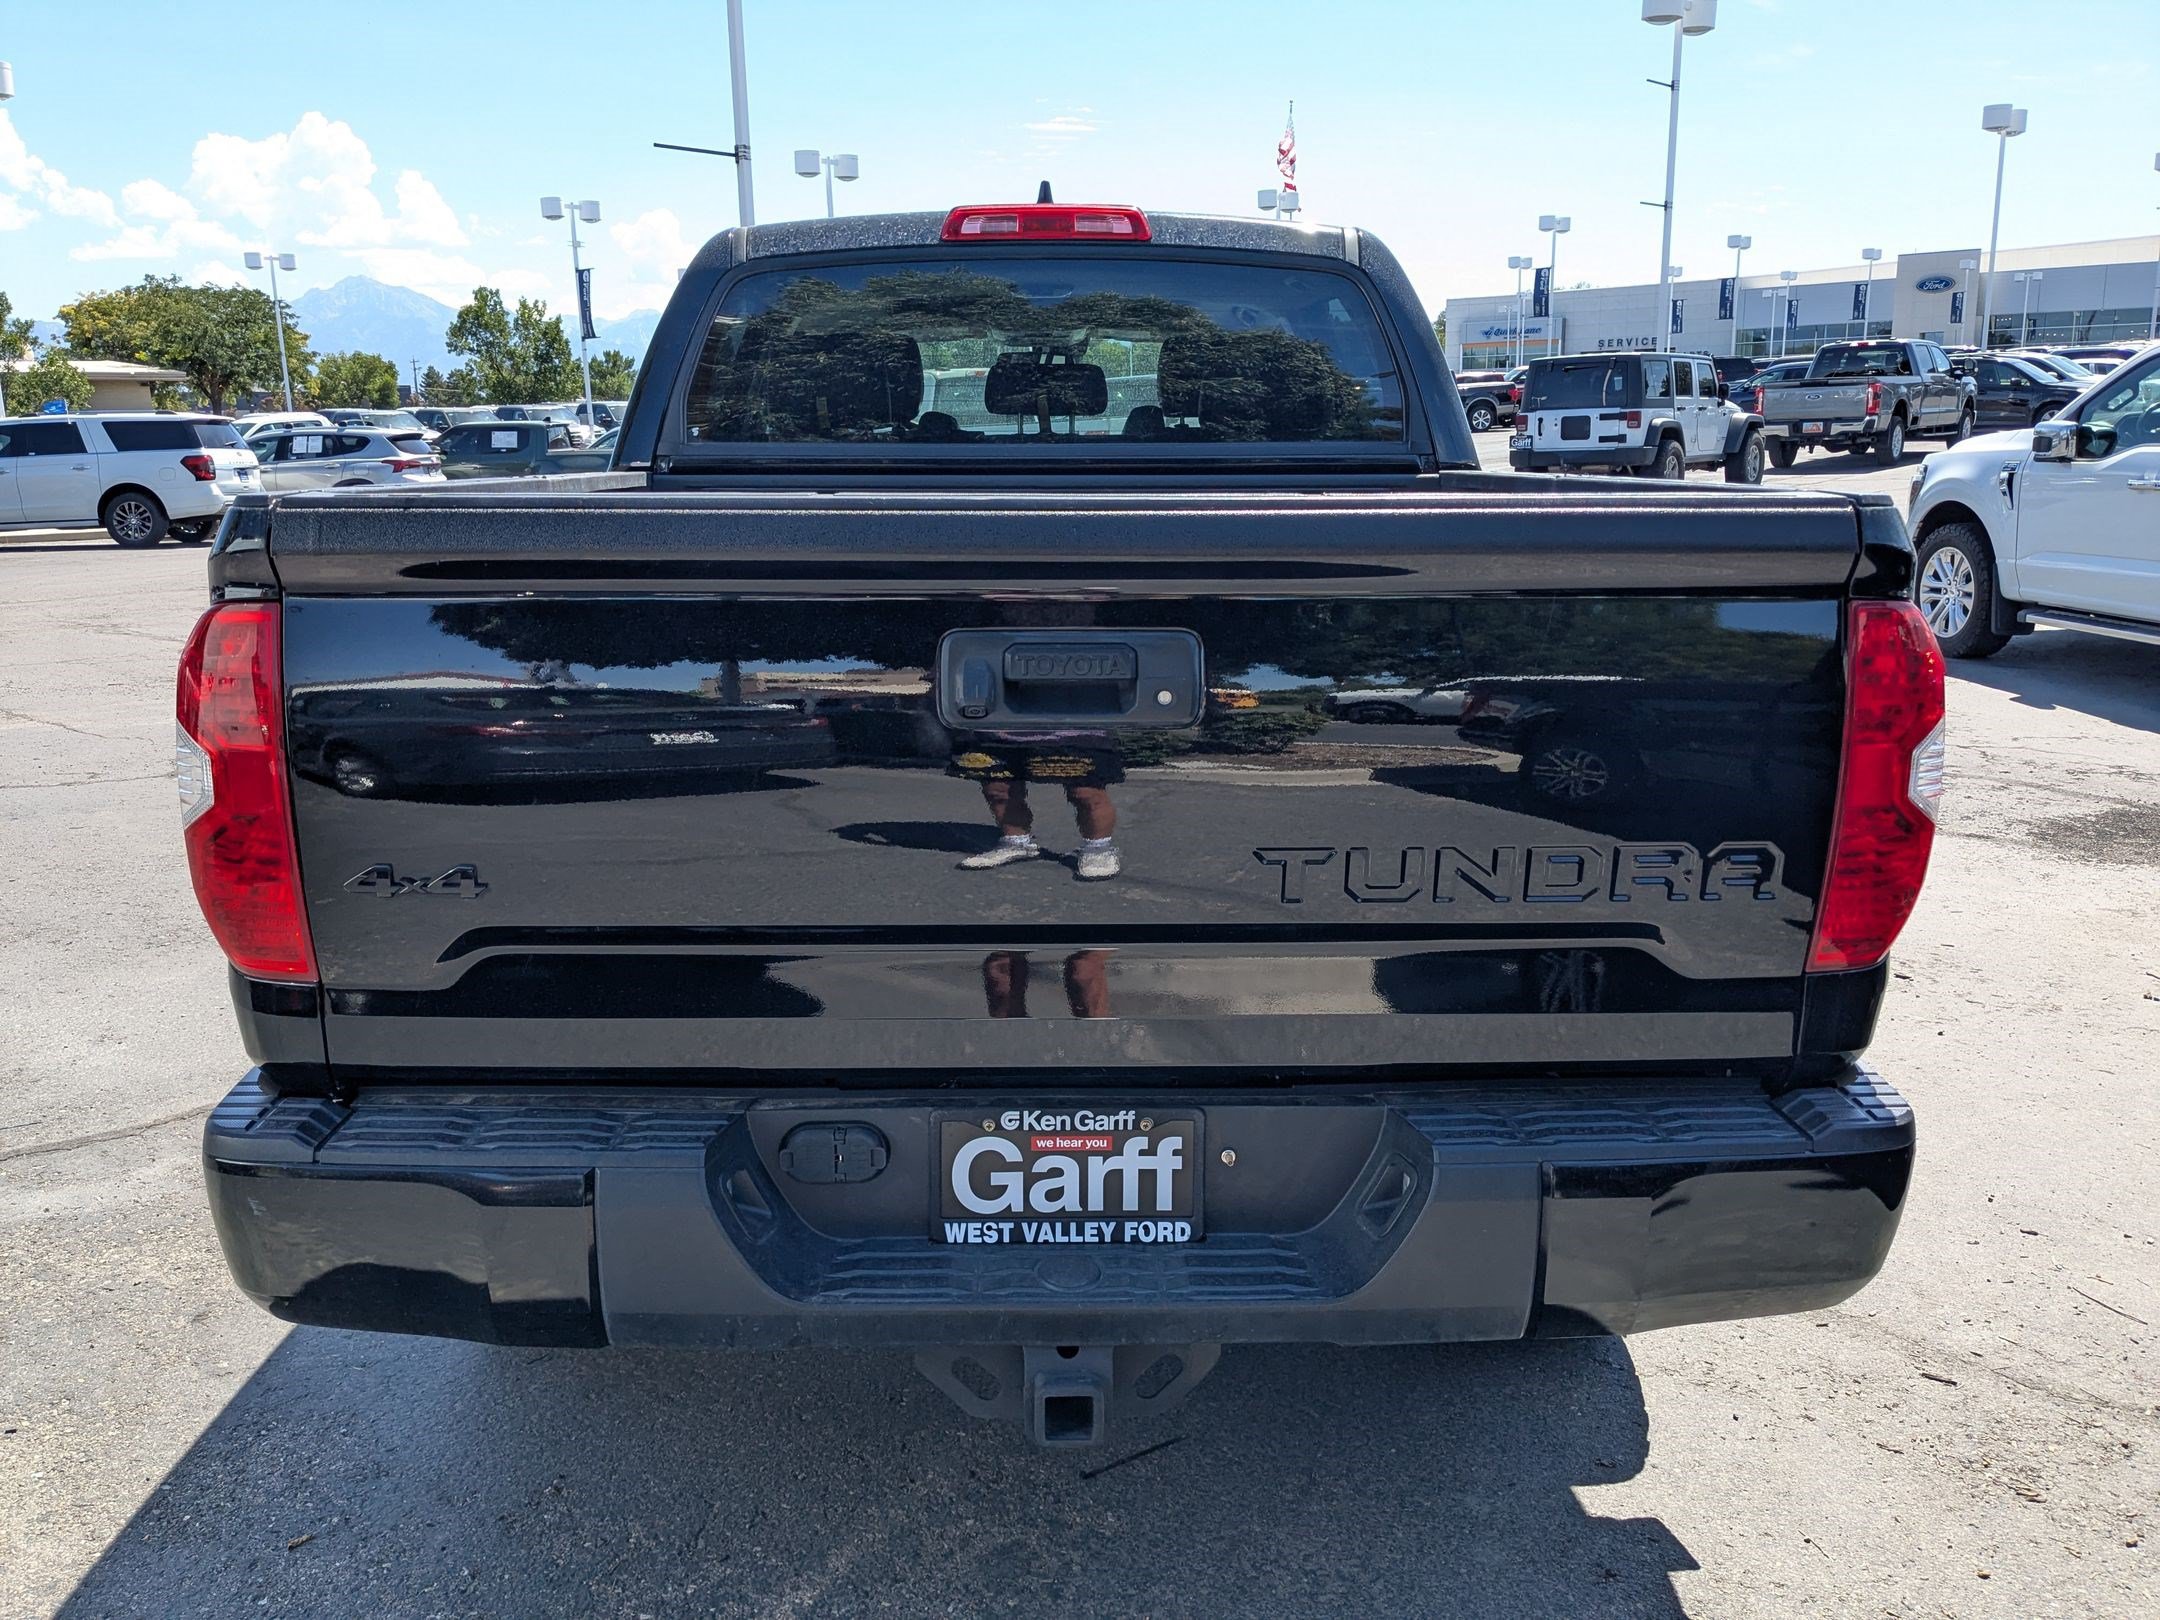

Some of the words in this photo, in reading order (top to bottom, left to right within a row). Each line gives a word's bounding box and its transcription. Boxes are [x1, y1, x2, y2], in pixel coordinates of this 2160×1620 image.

[1923, 280, 1945, 290] Ford
[1598, 337, 1657, 347] SERVICE
[1511, 438, 1532, 447] Garff
[1016, 654, 1127, 676] TOYOTA
[343, 862, 489, 898] 4x4
[1252, 841, 1786, 903] TUNDRA
[1023, 1110, 1071, 1131] Ken
[1074, 1110, 1136, 1131] Garff
[1036, 1139, 1054, 1148] we
[1056, 1137, 1084, 1148] hear
[1085, 1139, 1108, 1150] you
[951, 1136, 1183, 1214] Garff
[944, 1221, 1014, 1244] WEST
[1021, 1221, 1116, 1243] VALLEY
[1124, 1221, 1192, 1243] FORD
